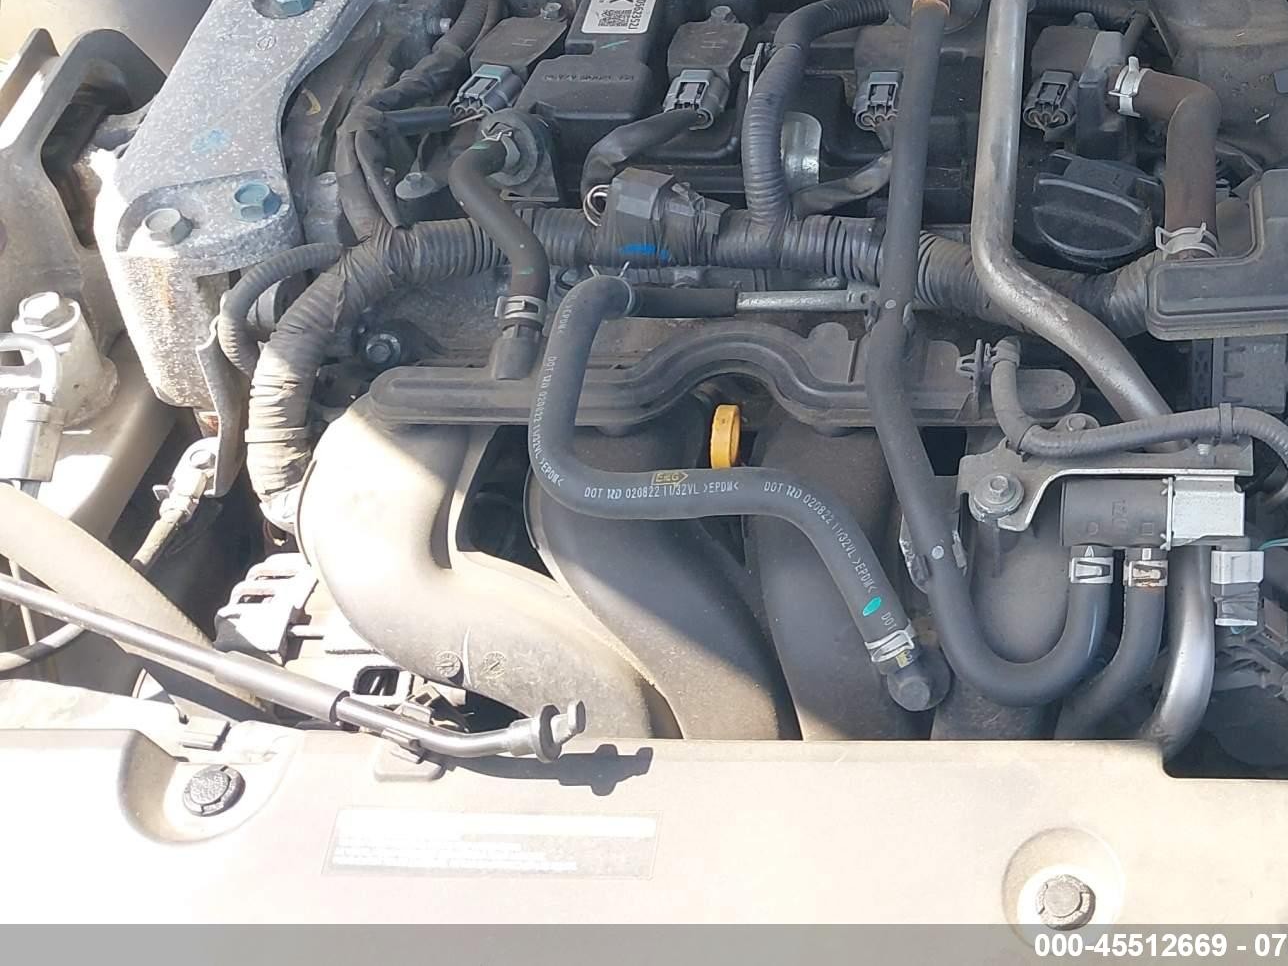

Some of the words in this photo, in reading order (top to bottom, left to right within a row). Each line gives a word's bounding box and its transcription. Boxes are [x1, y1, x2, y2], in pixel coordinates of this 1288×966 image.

[584, 486, 604, 499] DOT
[625, 485, 660, 499] 020822
[764, 481, 783, 493] DOT
[803, 495, 832, 525] 020822
